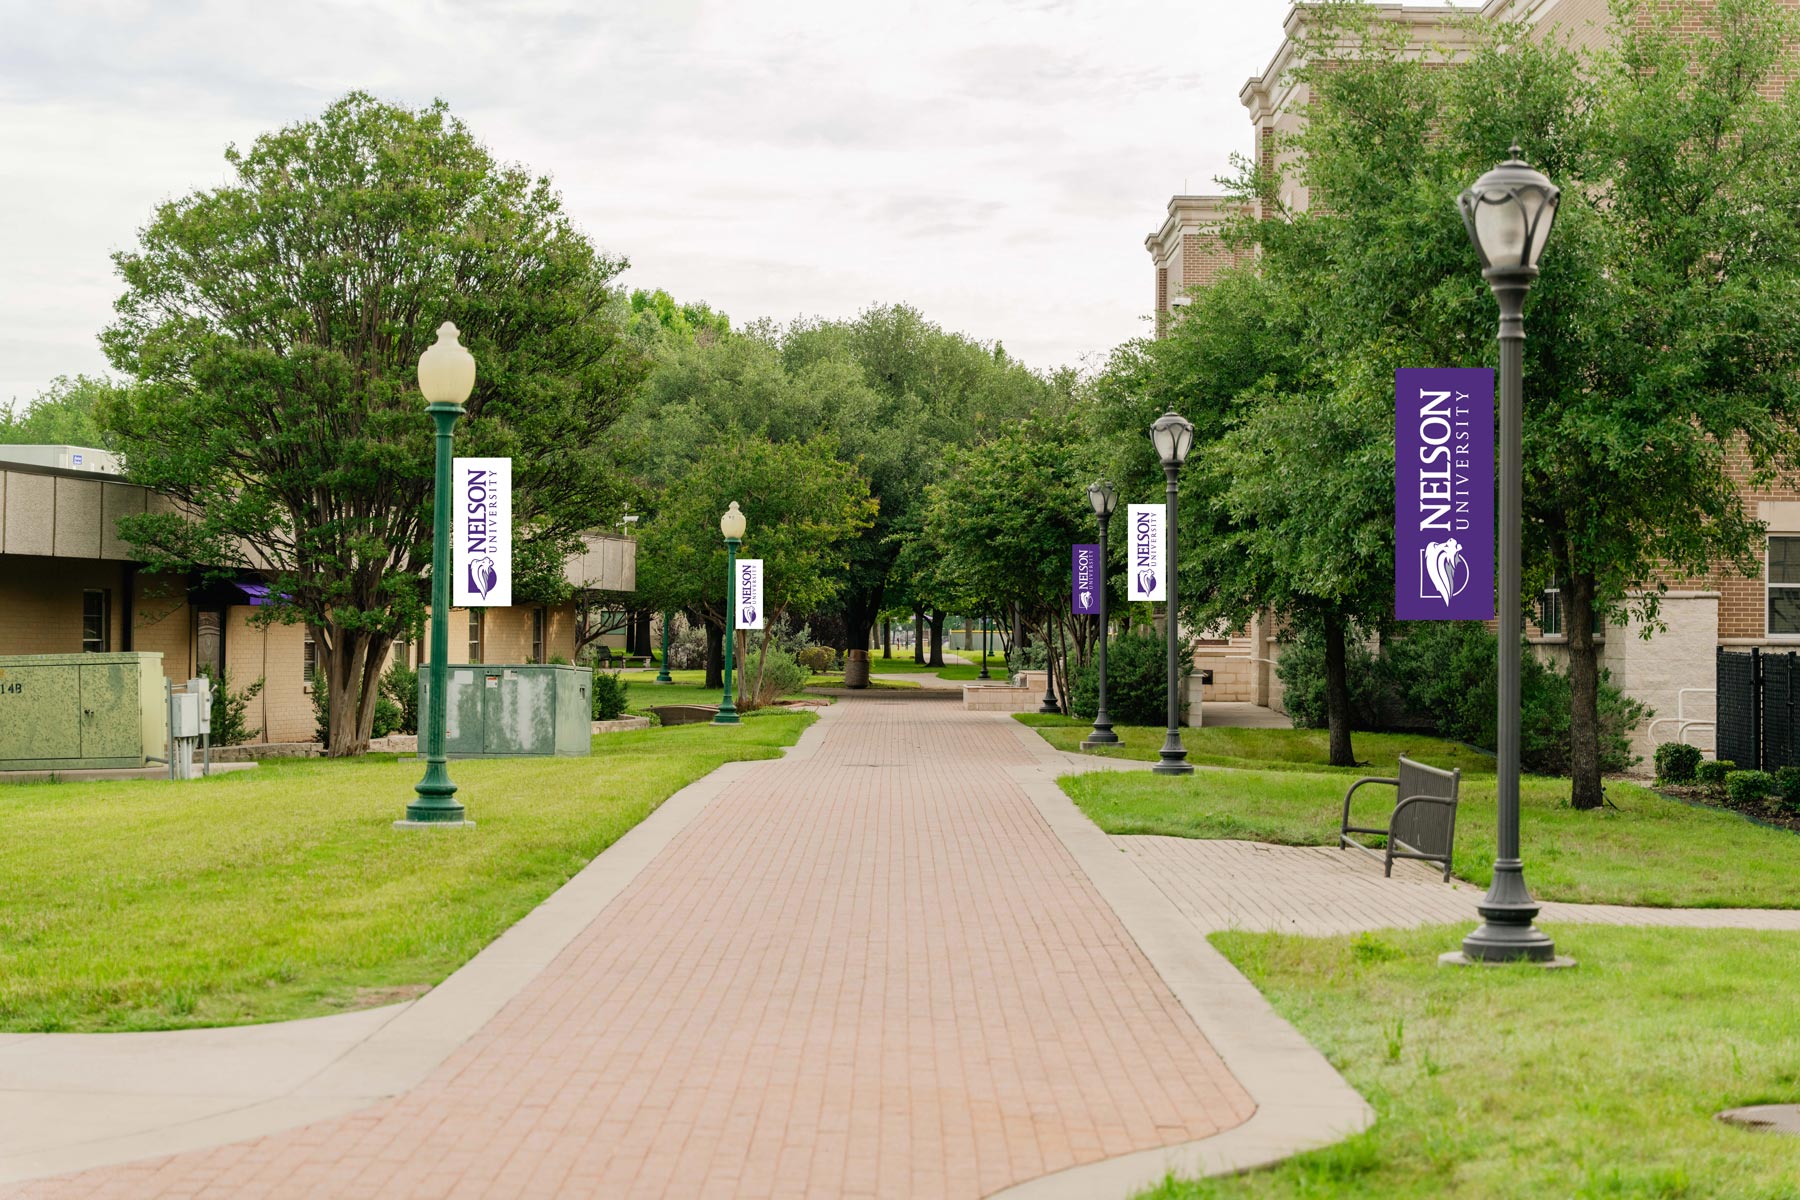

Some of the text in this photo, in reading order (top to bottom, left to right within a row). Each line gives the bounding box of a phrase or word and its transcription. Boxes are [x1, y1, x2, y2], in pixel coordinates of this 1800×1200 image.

[1419, 387, 1452, 531] NELSON
[1455, 390, 1470, 531] UNIVERSITY
[467, 469, 487, 553] NELSON
[488, 469, 498, 553] UNIVERSITY
[1137, 512, 1150, 567] NELSON
[742, 564, 752, 605] NELSON
[1078, 549, 1089, 590] NELSON
